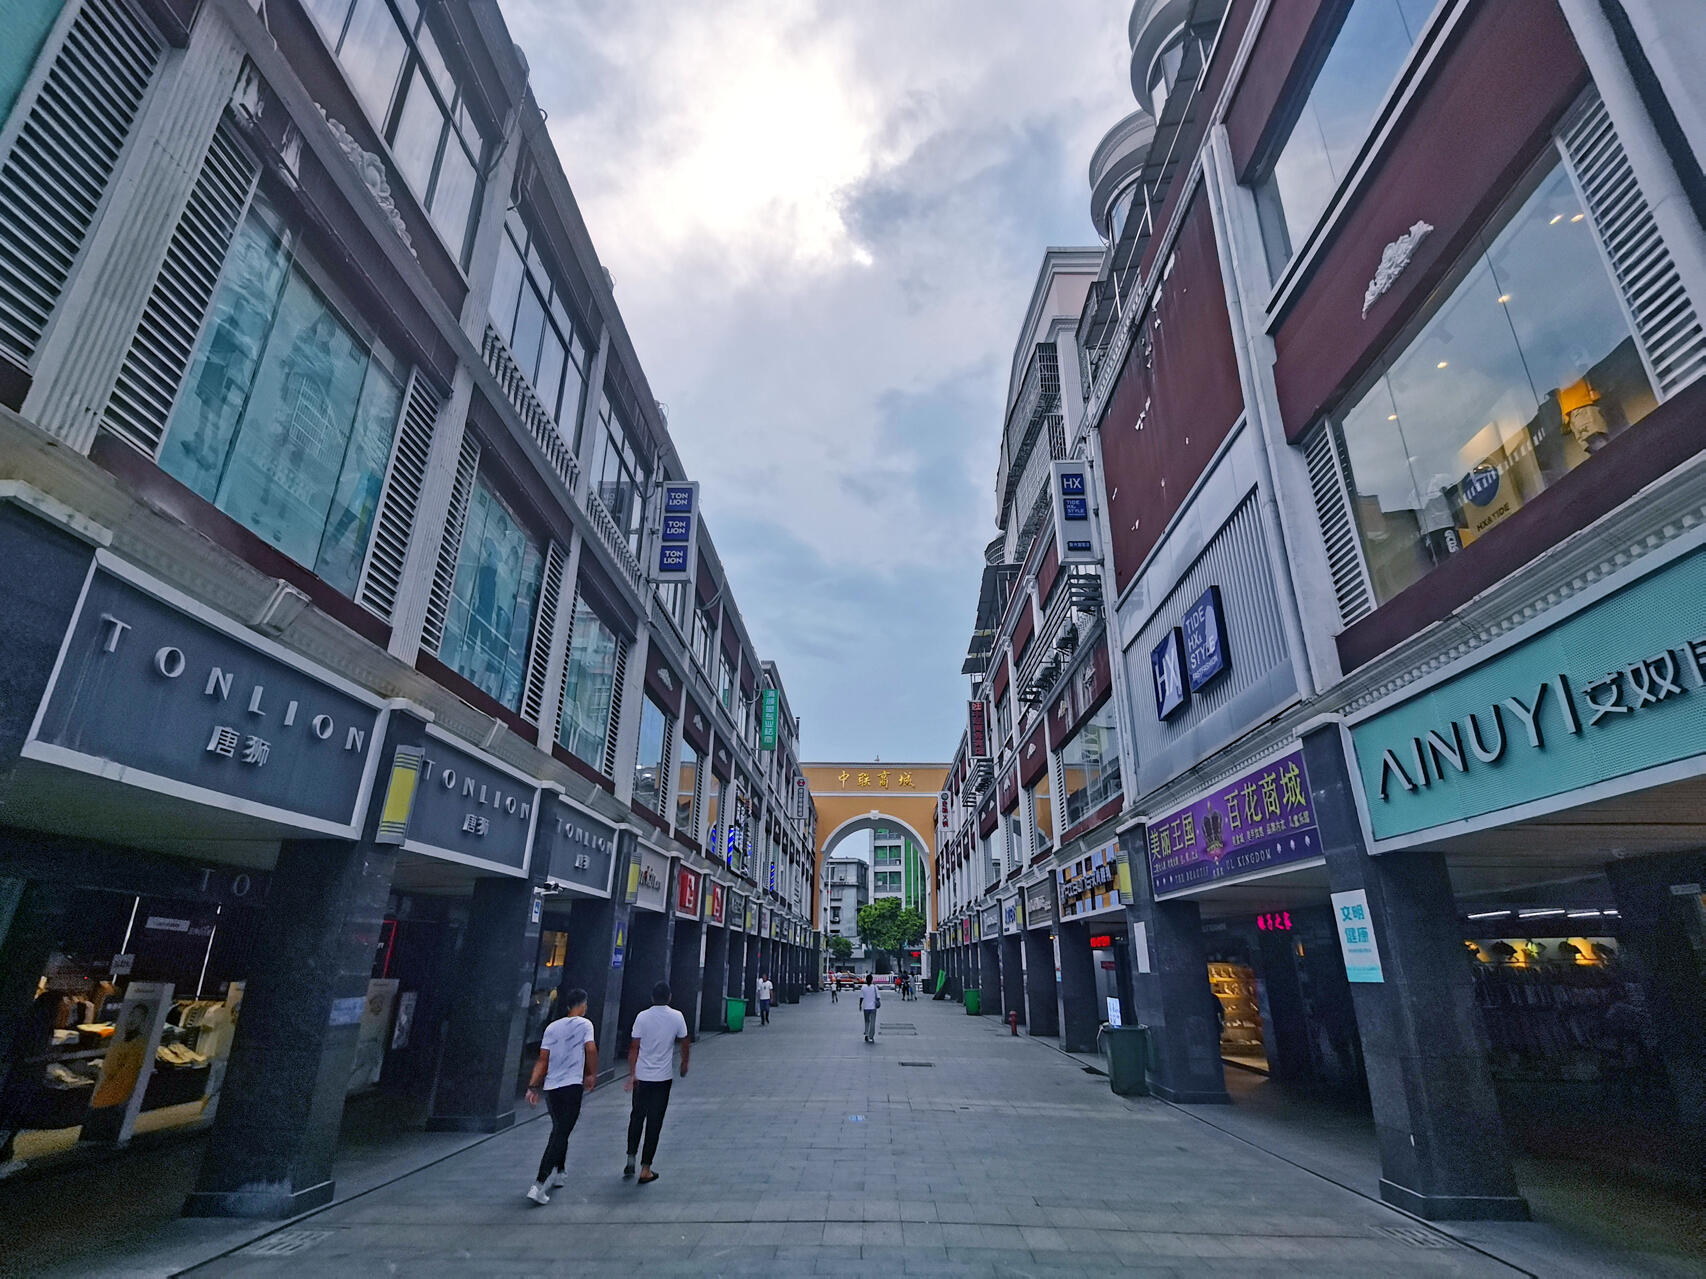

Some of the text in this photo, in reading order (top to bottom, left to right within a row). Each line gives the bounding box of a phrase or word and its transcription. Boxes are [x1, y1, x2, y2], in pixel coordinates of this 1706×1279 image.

[1063, 478, 1082, 489] HX
[1185, 605, 1206, 634] TIDE
[102, 613, 366, 754] TONLION
[1155, 647, 1182, 702] HX
[206, 725, 273, 768] 唐狮
[1378, 673, 1583, 801] AINUYI
[423, 757, 531, 821] TONLION
[838, 770, 916, 790] 中联商城
[1150, 761, 1307, 862] 美丽王国 百花商城
[556, 816, 614, 855] TONLION
[1237, 848, 1272, 868] KINGDOM
[1340, 904, 1365, 922] 文明
